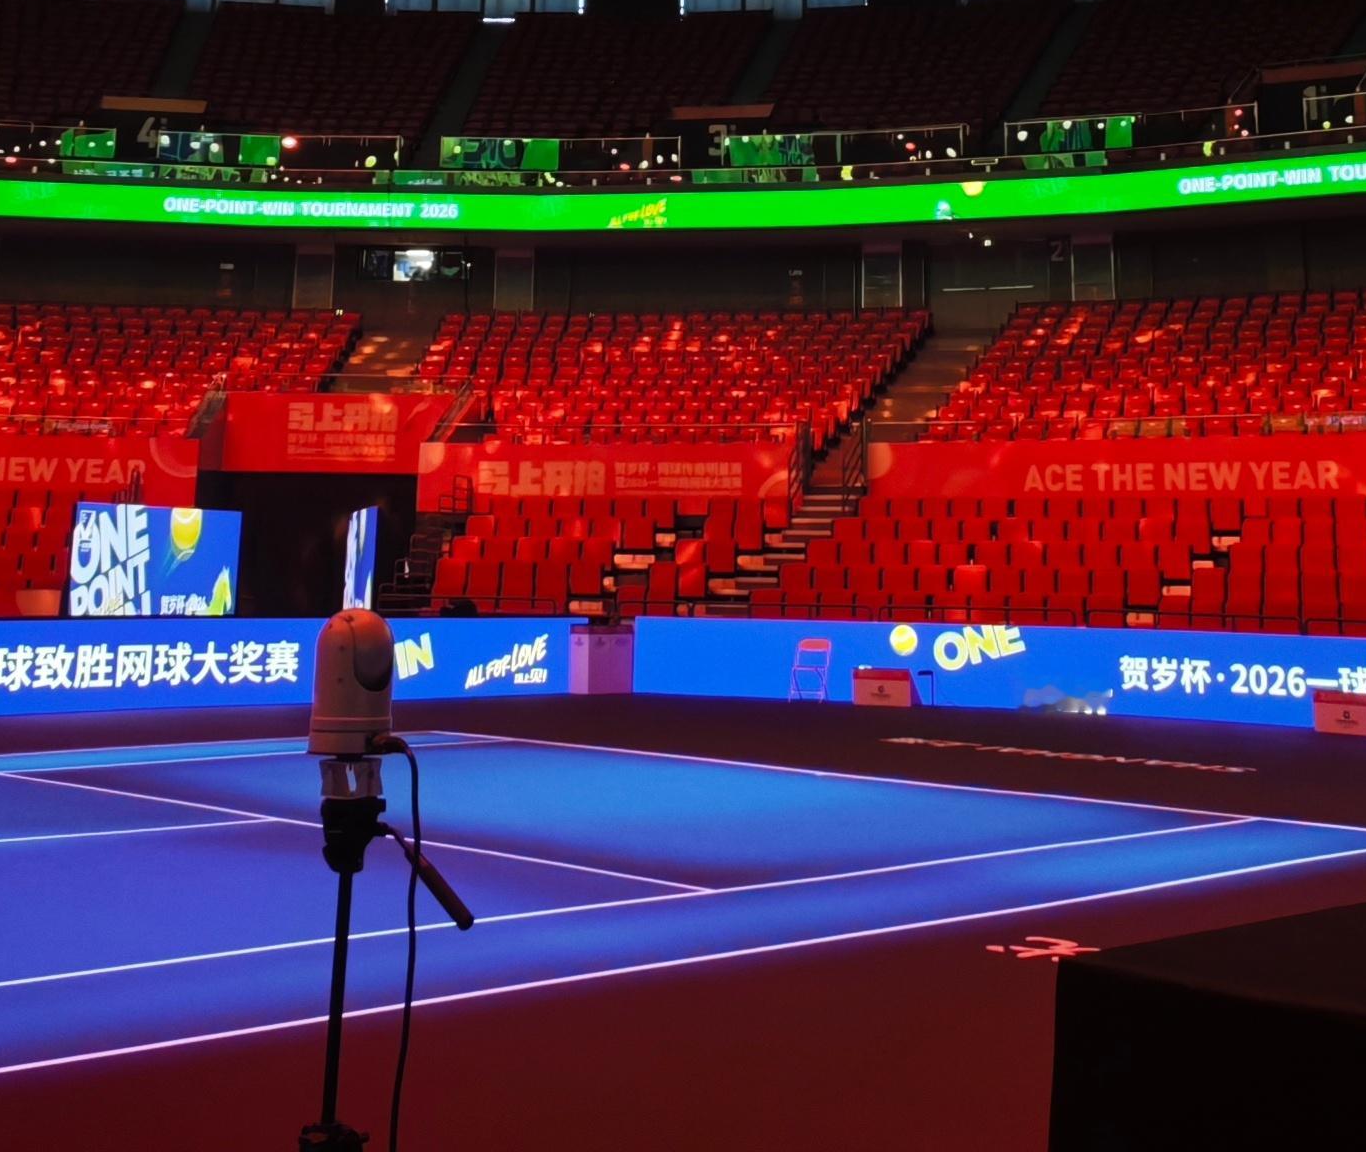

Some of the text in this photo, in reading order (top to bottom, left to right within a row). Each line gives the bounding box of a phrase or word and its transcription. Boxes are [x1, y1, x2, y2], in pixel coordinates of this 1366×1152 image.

[1179, 165, 1322, 195] ONE-POINT-WIN
[163, 196, 459, 219] ONE-POINT-WIN TOURNAMENT 2026
[64, 458, 145, 486] YEAR
[1023, 459, 1340, 493] ACE THE NEW YEAR
[70, 504, 150, 585] ONE
[70, 549, 150, 616] POINT
[393, 632, 435, 680] IN
[464, 633, 549, 690] ALL FOR LOVE
[933, 625, 1027, 672] ONE
